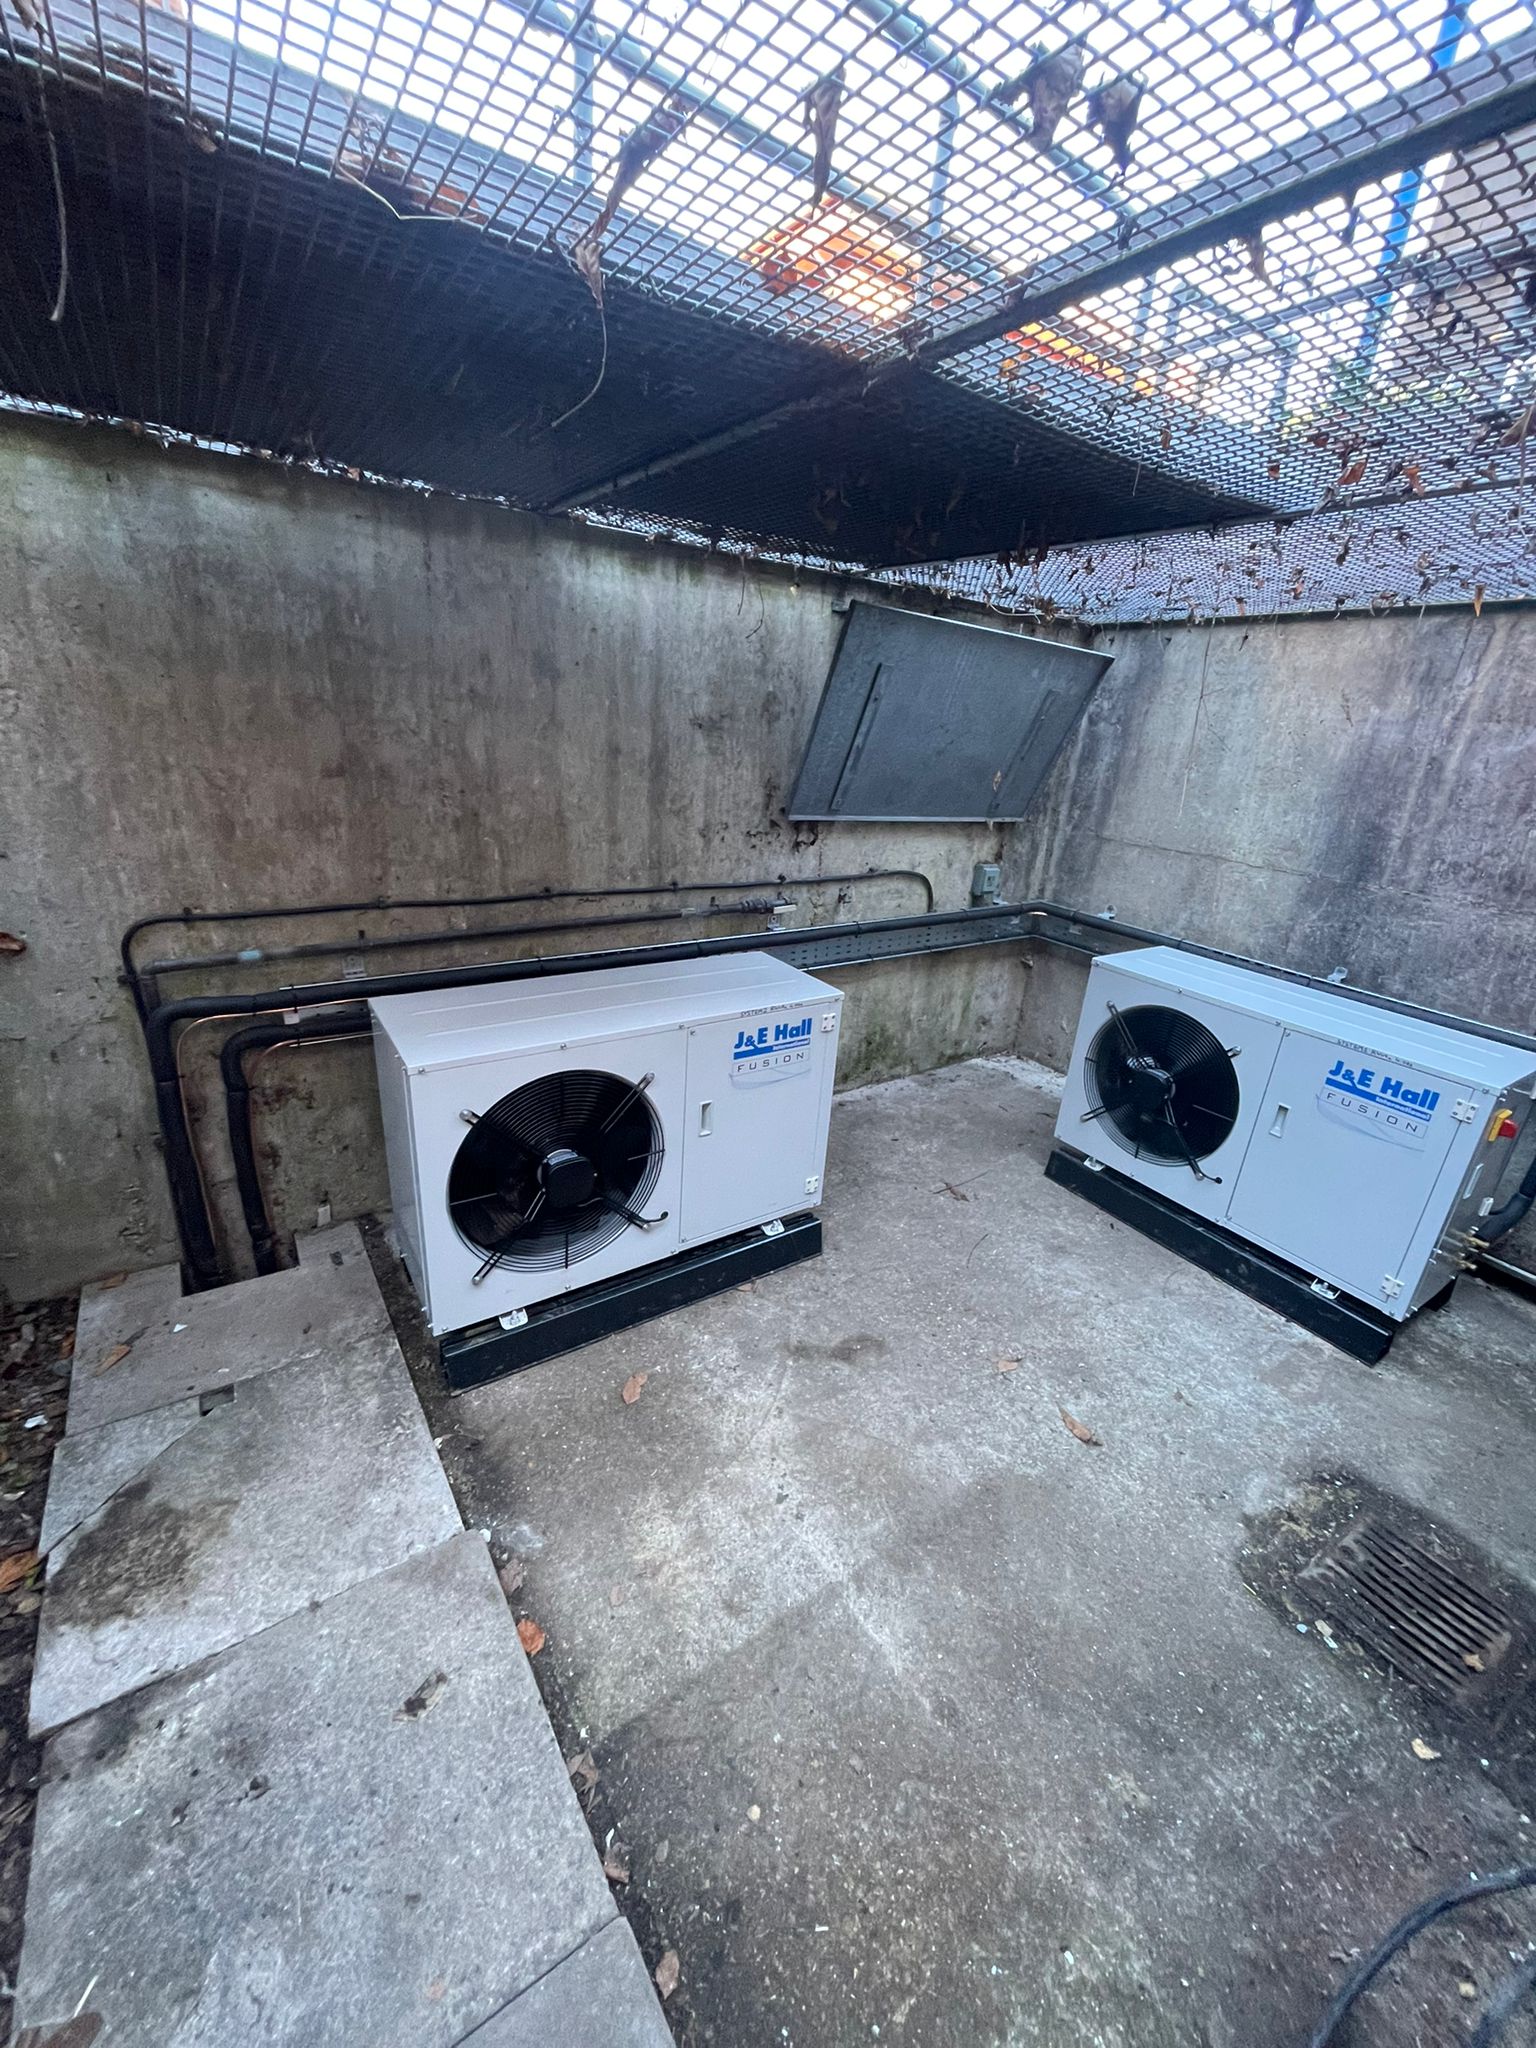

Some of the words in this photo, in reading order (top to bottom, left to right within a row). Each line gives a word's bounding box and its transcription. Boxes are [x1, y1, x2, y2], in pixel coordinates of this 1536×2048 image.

[734, 1027, 768, 1049] J&E
[774, 1018, 812, 1041] Hall
[737, 1052, 804, 1072] FUSION
[1329, 1060, 1375, 1088] J&E
[1380, 1076, 1440, 1111] Hall
[1326, 1092, 1418, 1133] FUSION
